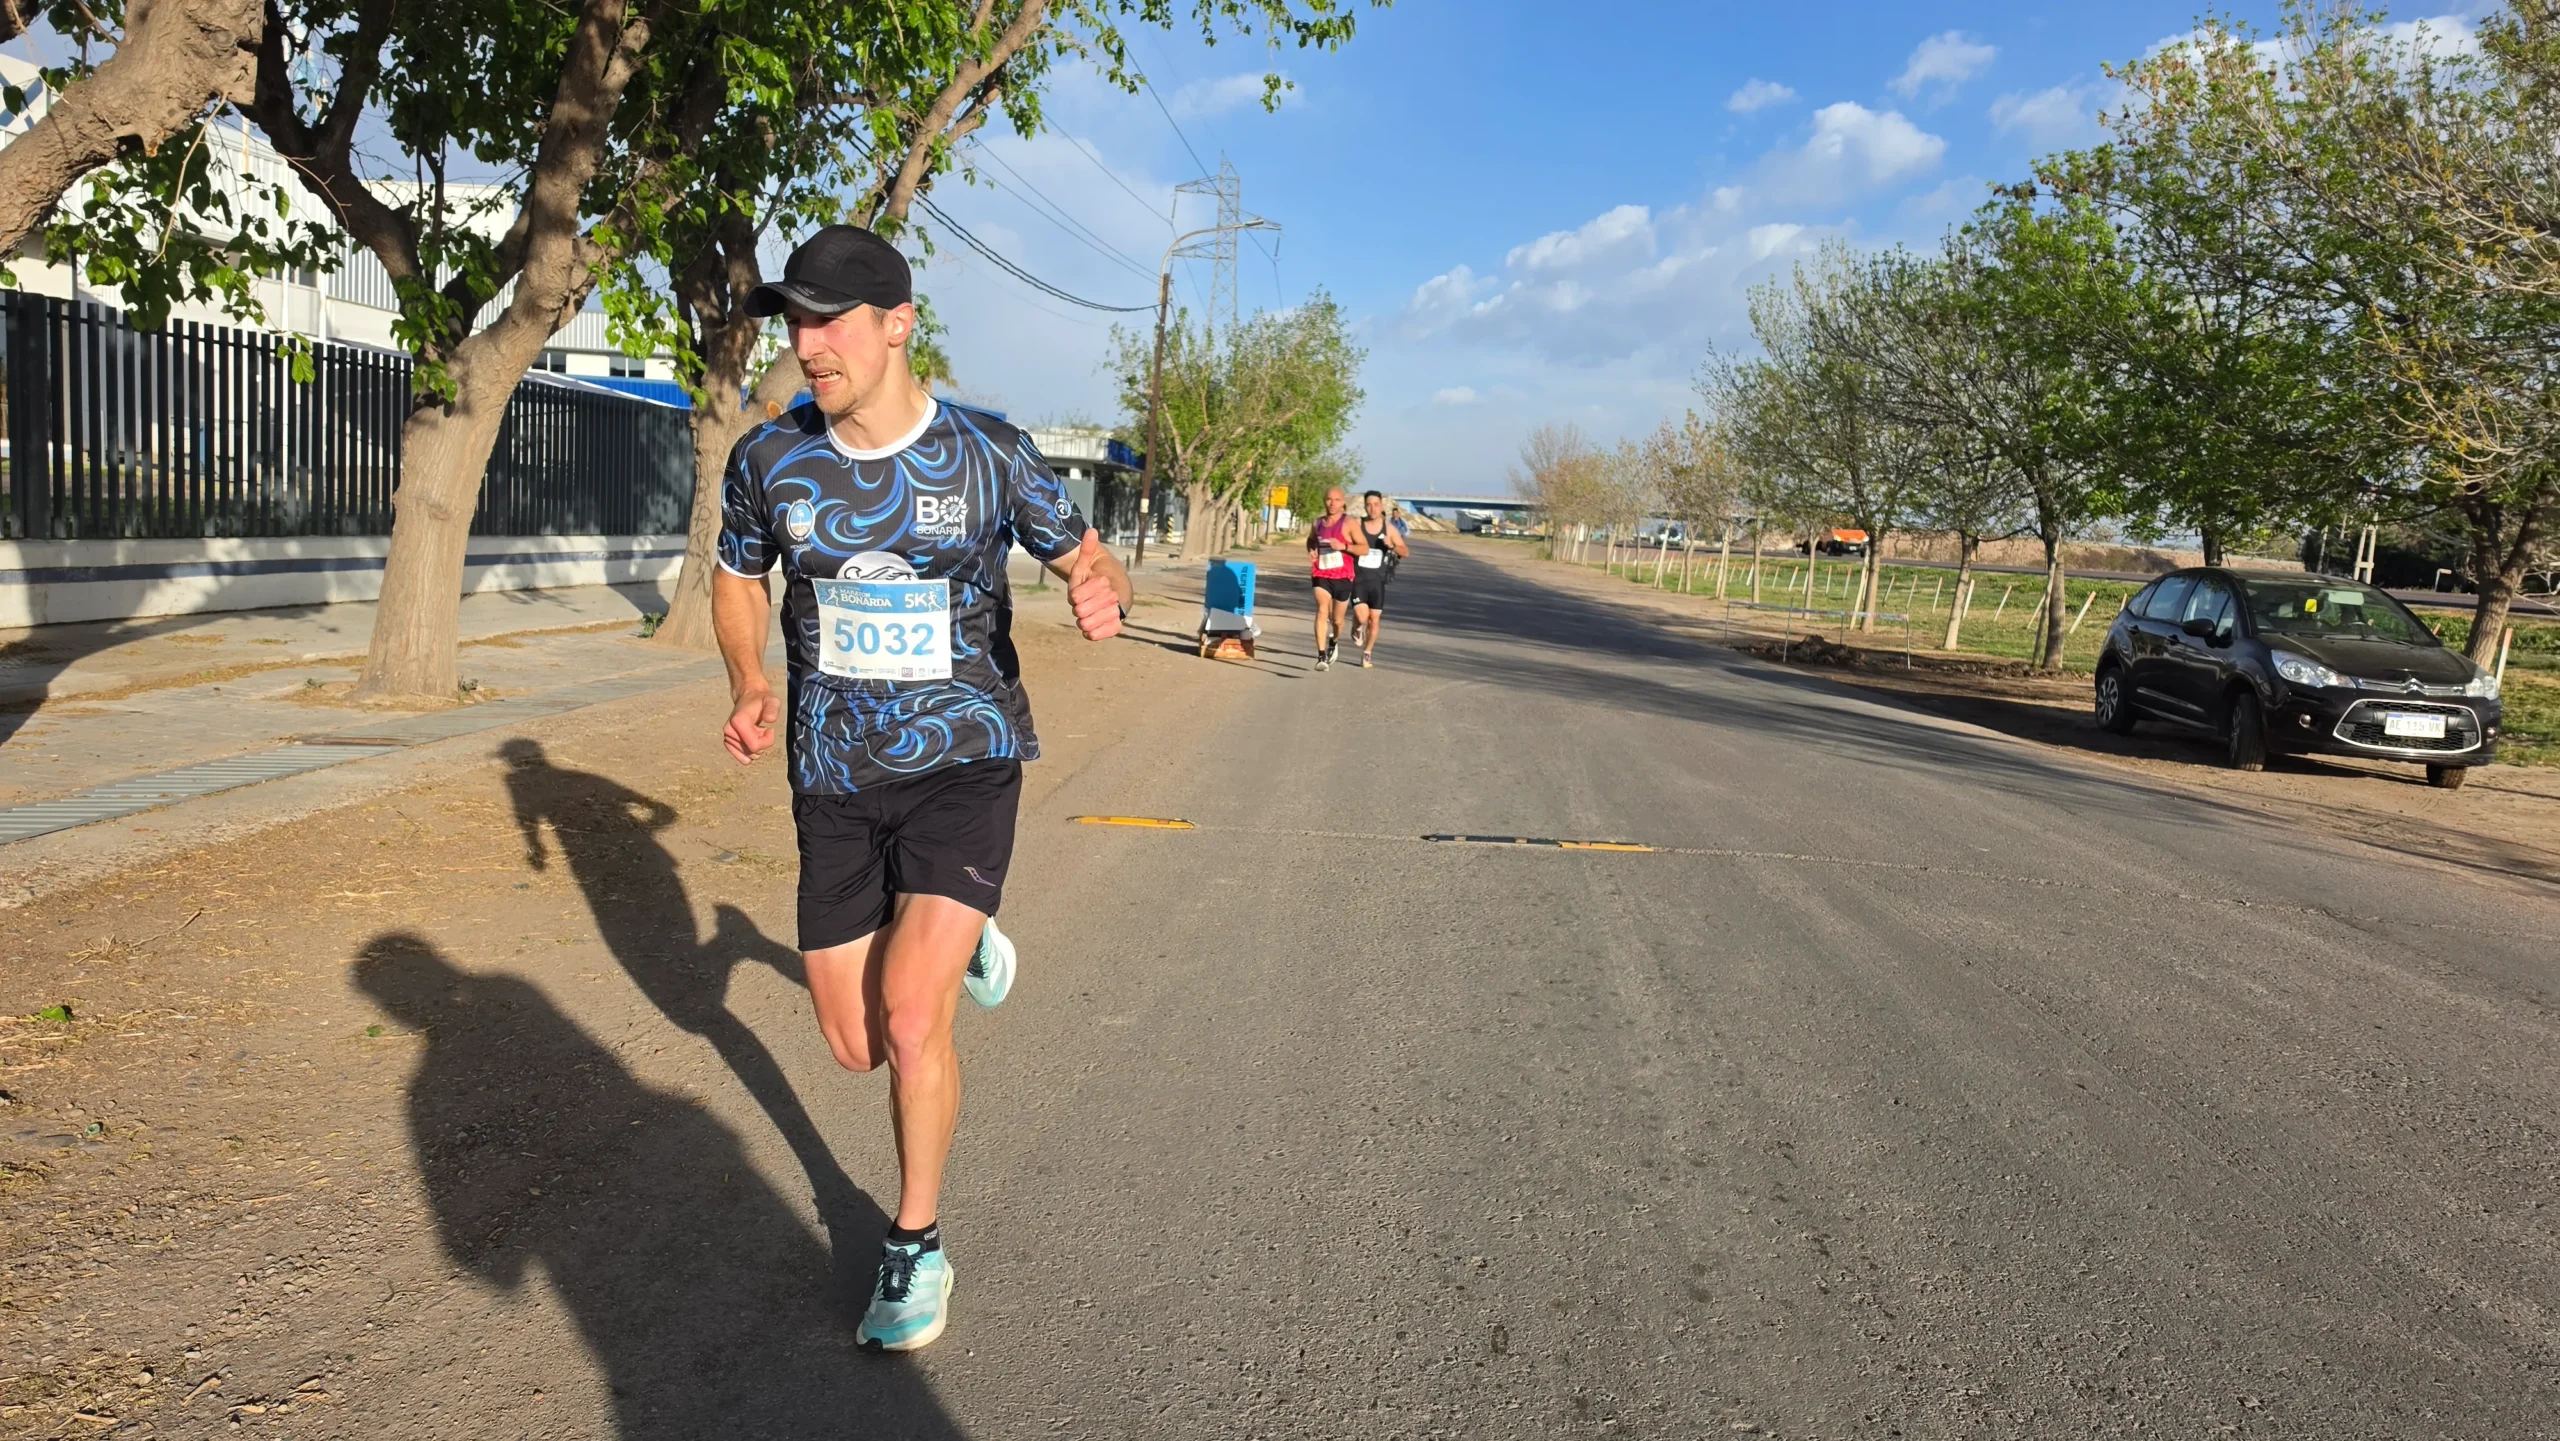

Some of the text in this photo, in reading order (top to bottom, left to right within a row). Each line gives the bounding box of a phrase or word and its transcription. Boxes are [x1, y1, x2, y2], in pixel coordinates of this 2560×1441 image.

[916, 525, 967, 535] BONARDA
[840, 593, 892, 607] BONARDA
[904, 593, 927, 608] 5K
[834, 618, 935, 656] 5032
[2389, 719, 2401, 730] AE
